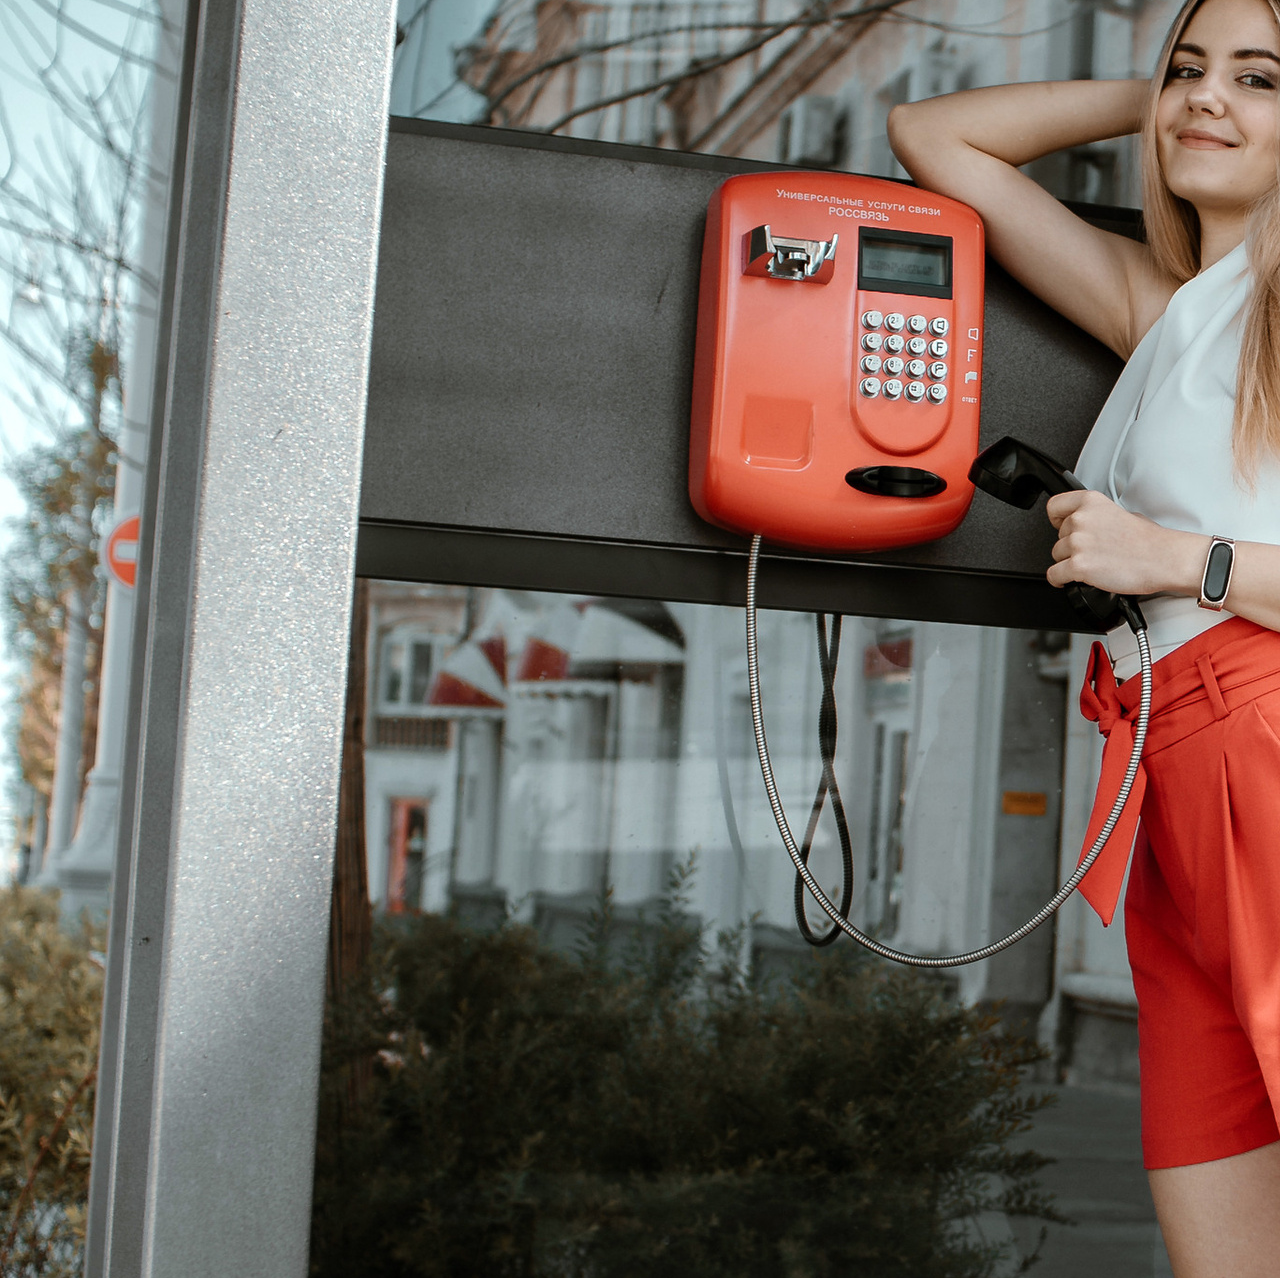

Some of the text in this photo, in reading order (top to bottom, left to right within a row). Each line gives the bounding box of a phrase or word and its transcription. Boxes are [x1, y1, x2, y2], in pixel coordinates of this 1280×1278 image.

[776, 189, 941, 216] УНИВЕРСАЛЬНЫЕ УСЛУГИ СВЯЗИ
[828, 207, 890, 222] РОССВЯЗЬ
[936, 342, 944, 352] F
[967, 349, 977, 362] F
